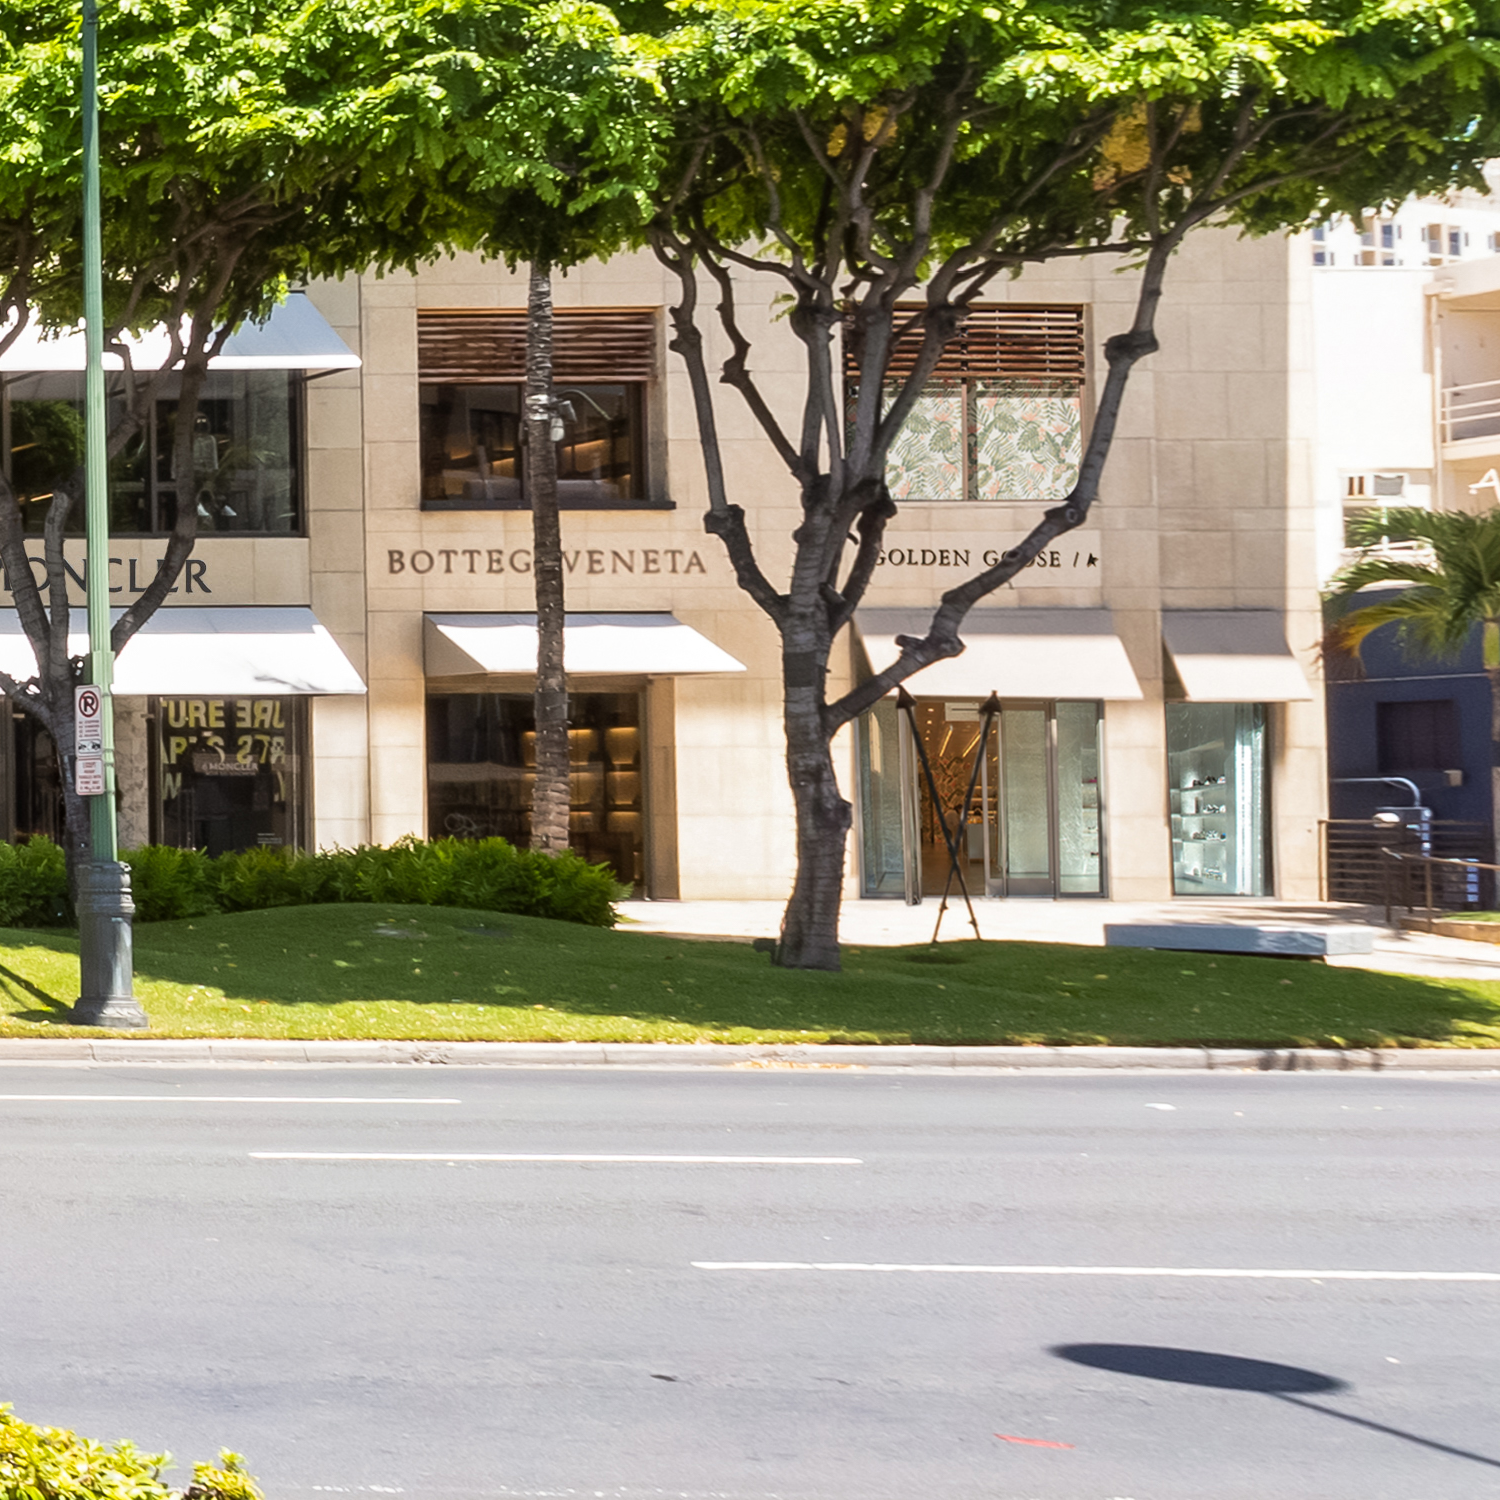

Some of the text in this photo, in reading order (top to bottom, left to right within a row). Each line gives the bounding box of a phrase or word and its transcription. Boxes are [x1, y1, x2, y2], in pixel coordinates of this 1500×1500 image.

[387, 549, 707, 575] BOTTEG VENETA
[983, 550, 1062, 569] GSE
